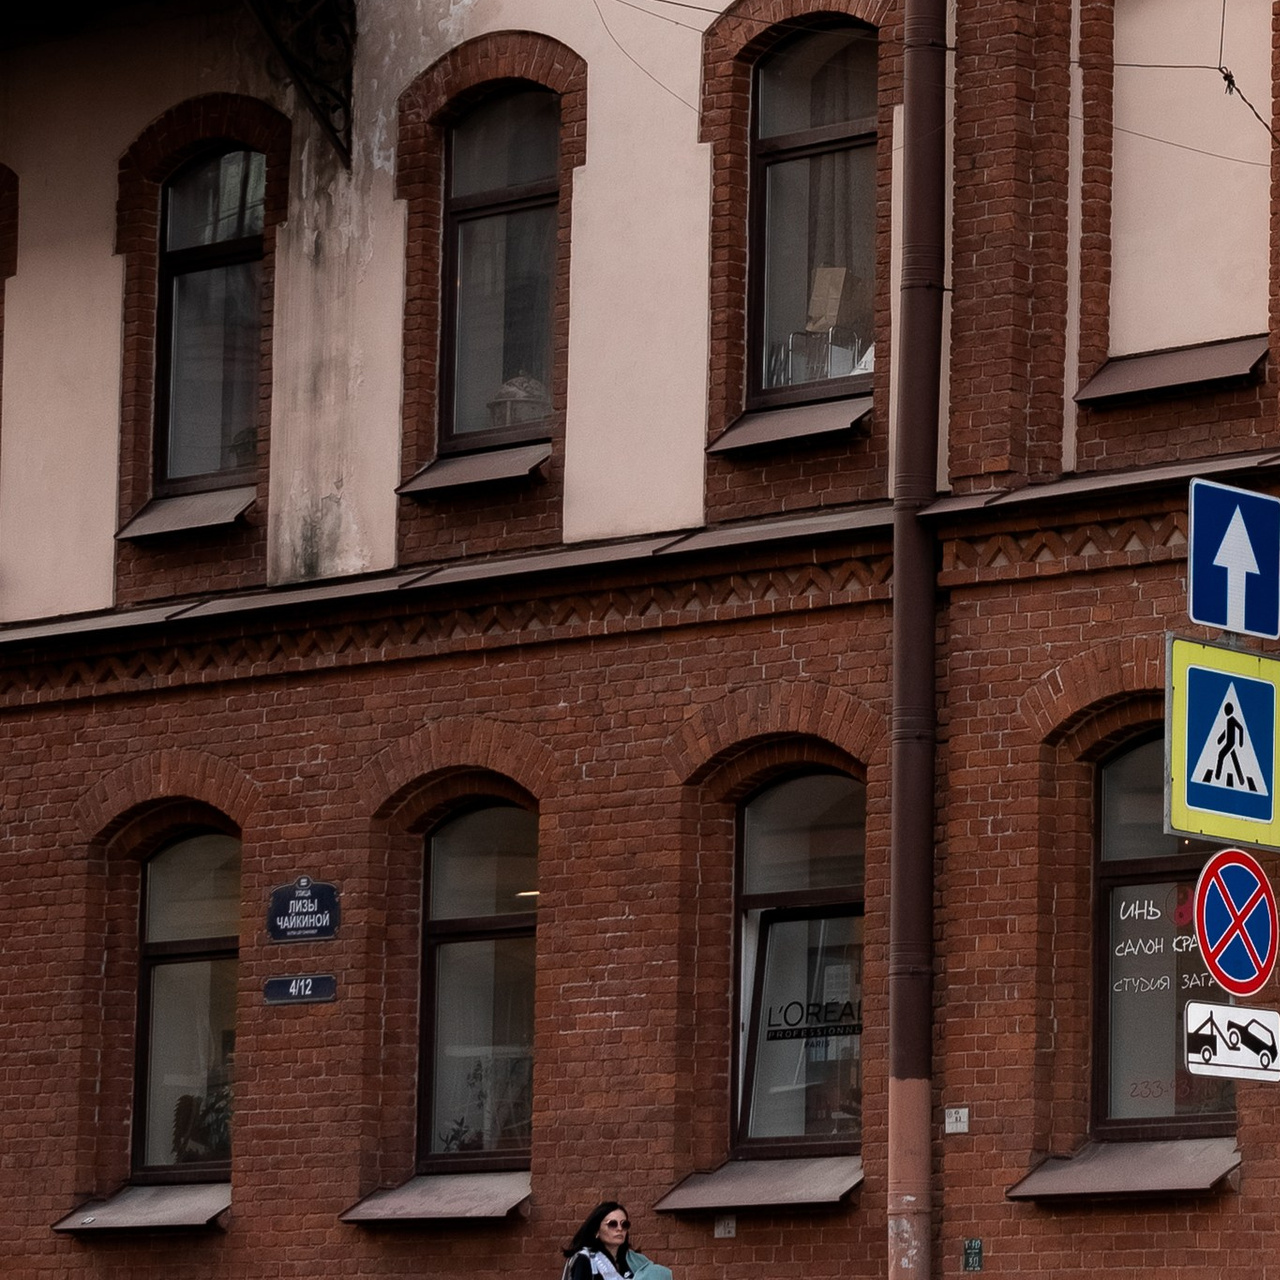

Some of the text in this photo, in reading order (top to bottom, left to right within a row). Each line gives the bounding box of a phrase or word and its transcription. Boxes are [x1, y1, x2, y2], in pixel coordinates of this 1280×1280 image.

[288, 899, 318, 913] ЛИЗЫ
[1120, 900, 1161, 920] ИНЬ
[276, 911, 330, 929] ЧАЙКИНОЙ
[1115, 934, 1199, 956] САЛОН КРА
[289, 979, 313, 996] 4/12
[1113, 976, 1170, 993] СТУДИЯ
[768, 1026, 861, 1039] PROFESSIONNE
